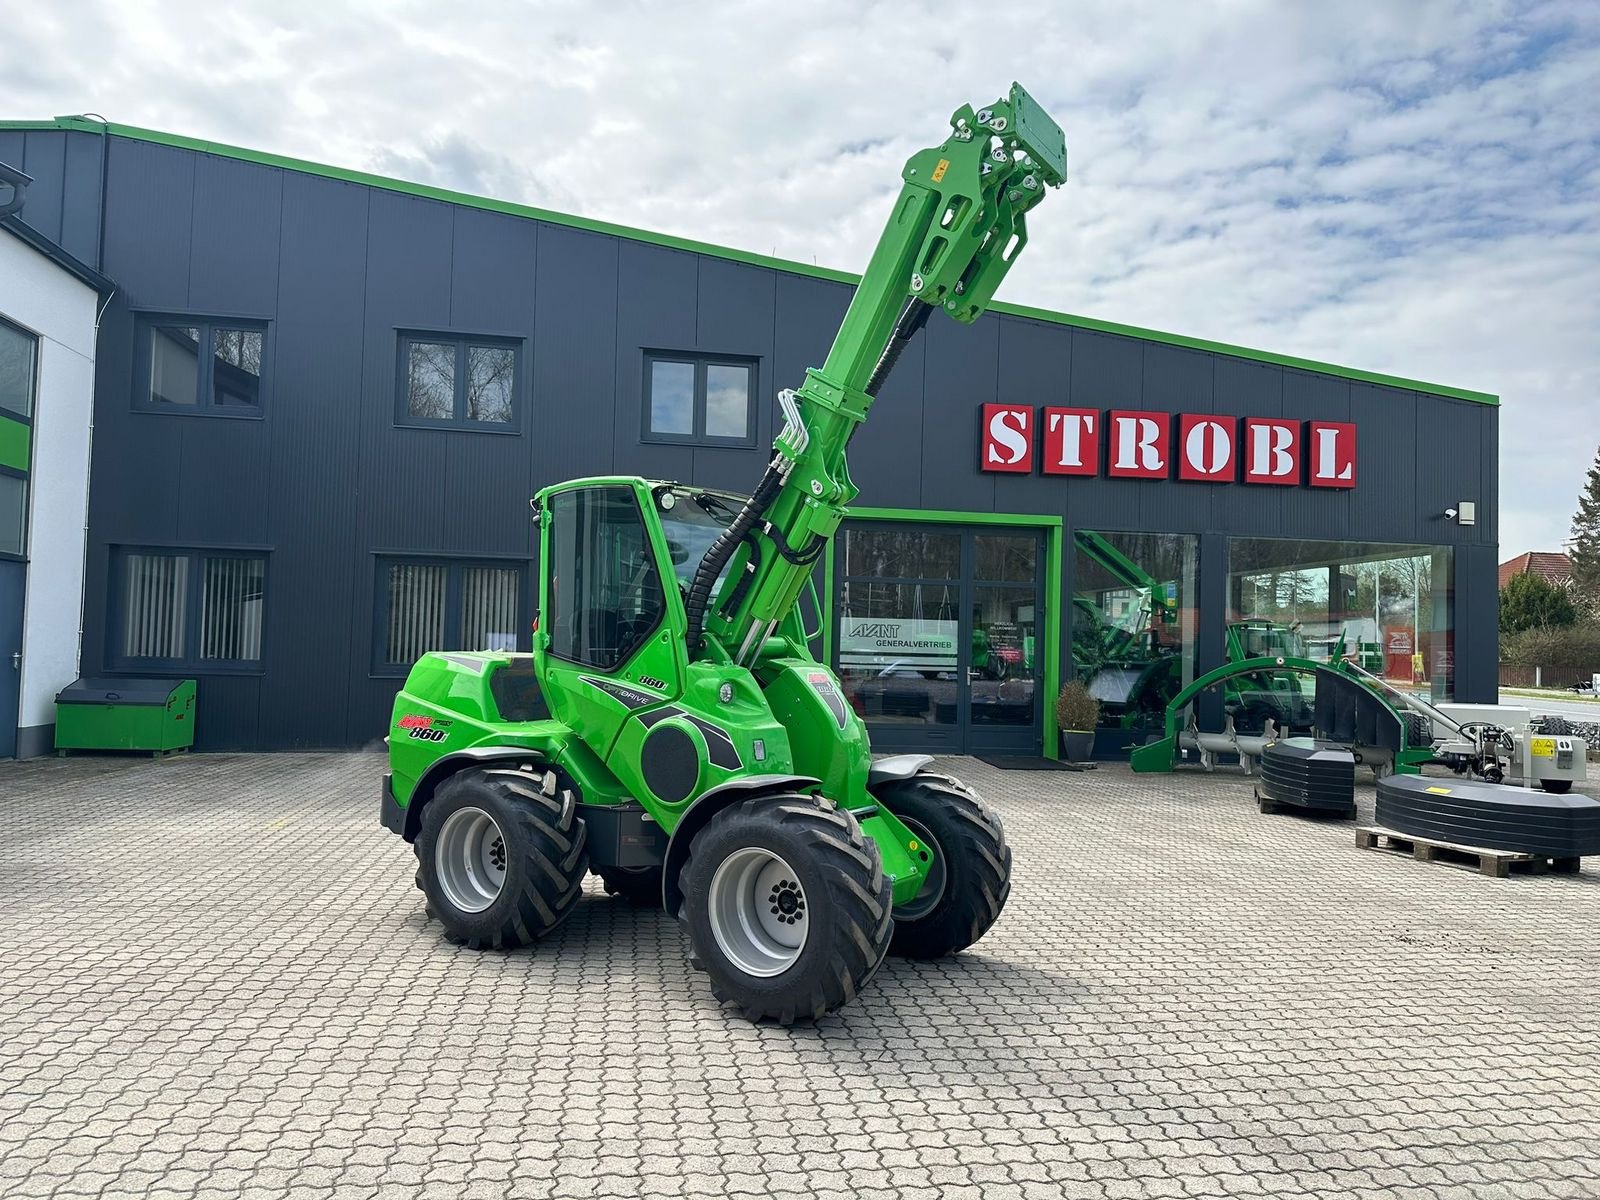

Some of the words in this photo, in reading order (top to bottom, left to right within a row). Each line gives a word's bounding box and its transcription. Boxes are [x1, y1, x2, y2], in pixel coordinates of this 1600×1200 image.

[987, 409, 1353, 480] STROBL
[849, 624, 900, 638] AVANT
[875, 639, 952, 649] GENERALVERTRIEB
[602, 683, 649, 705] OPTIDRIVE
